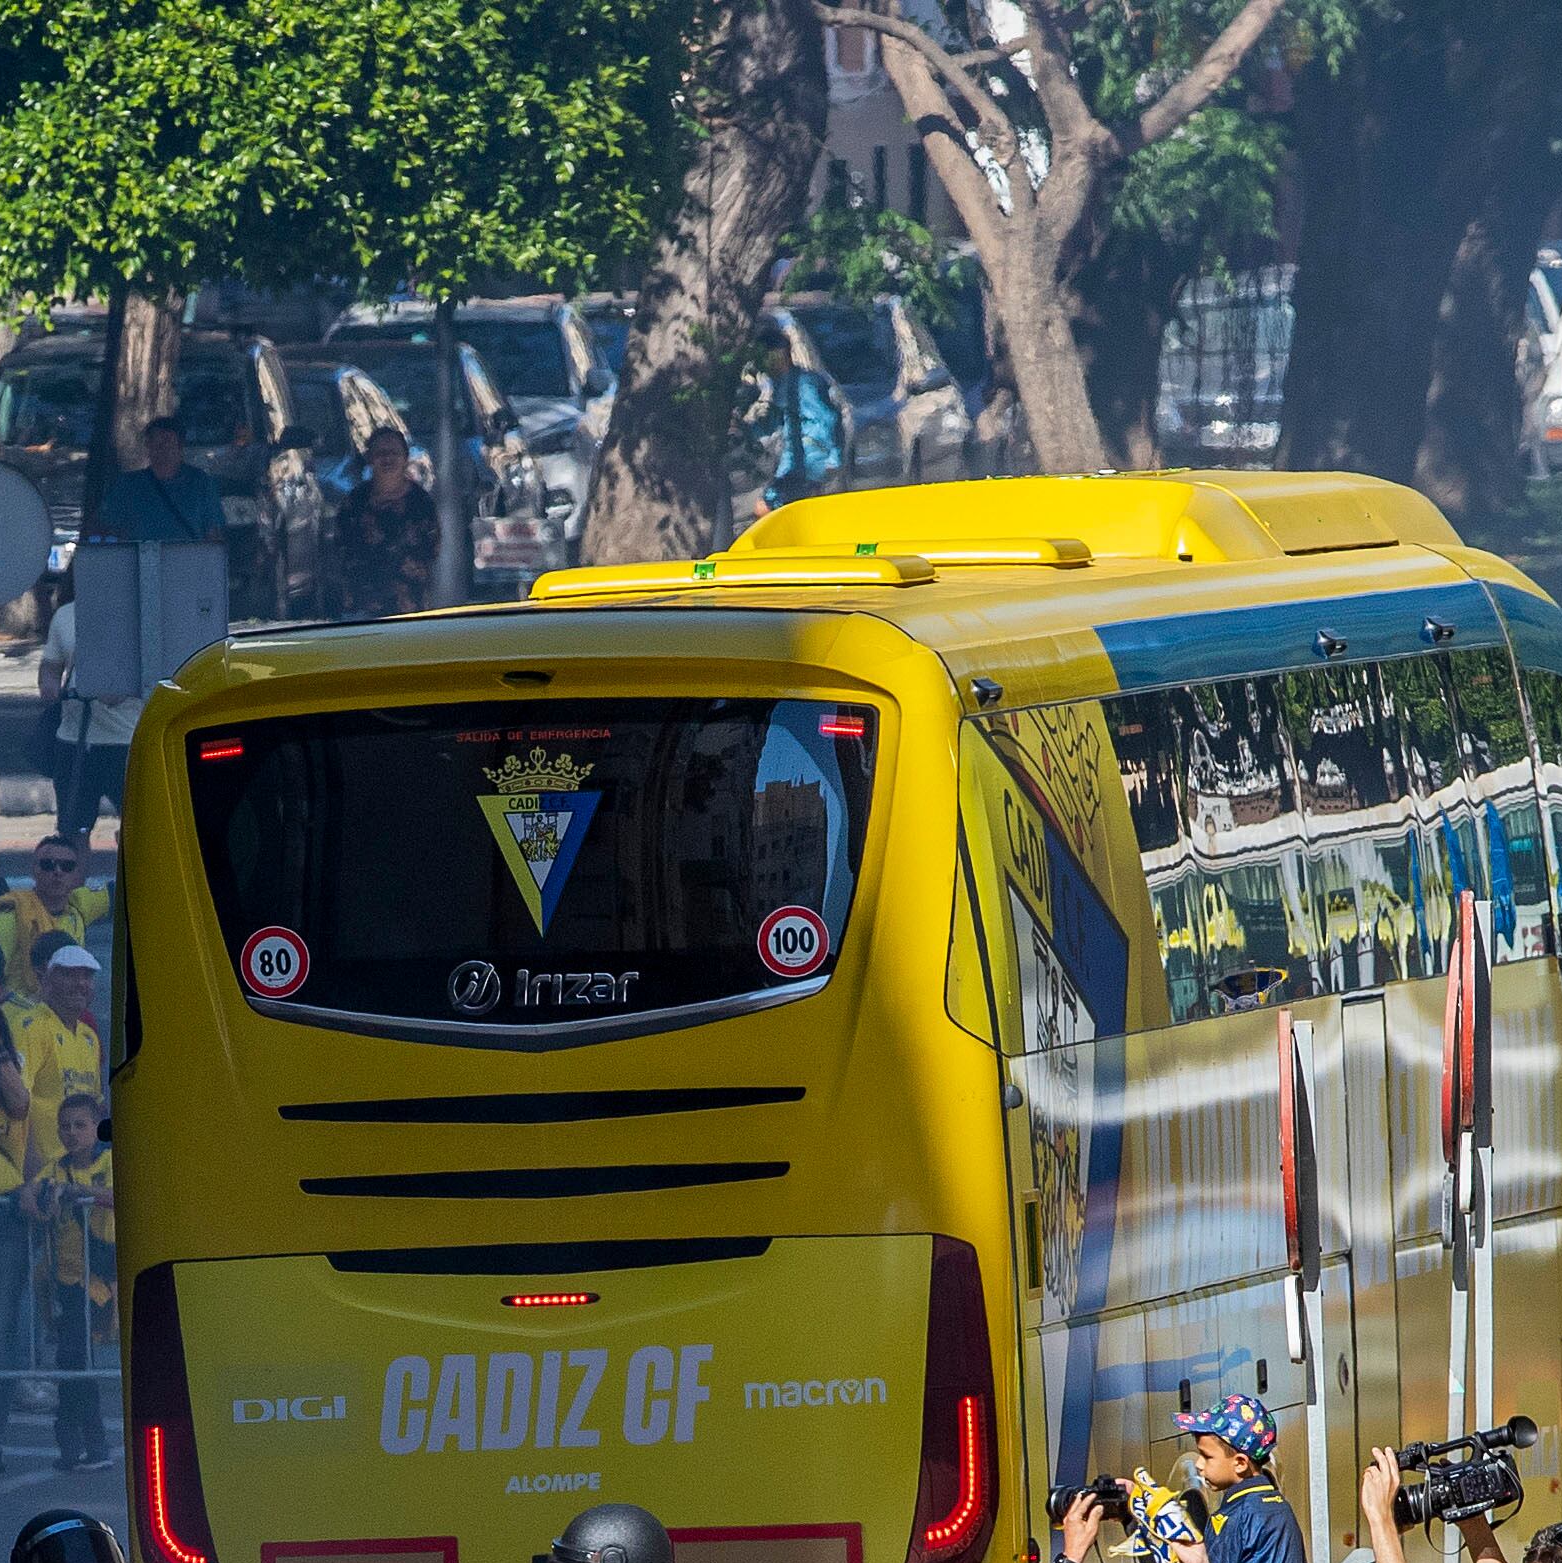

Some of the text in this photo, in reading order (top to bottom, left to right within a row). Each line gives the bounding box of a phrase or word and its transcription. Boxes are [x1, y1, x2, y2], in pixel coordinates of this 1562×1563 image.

[456, 727, 611, 743] SALIDA DE EMERGENCIA
[772, 925, 816, 955] 100
[259, 947, 291, 976] 80
[379, 1344, 714, 1456] CADIZ CF
[744, 1377, 887, 1409] macron
[233, 1396, 347, 1424] DIGI
[505, 1472, 602, 1494] ALOMPE
